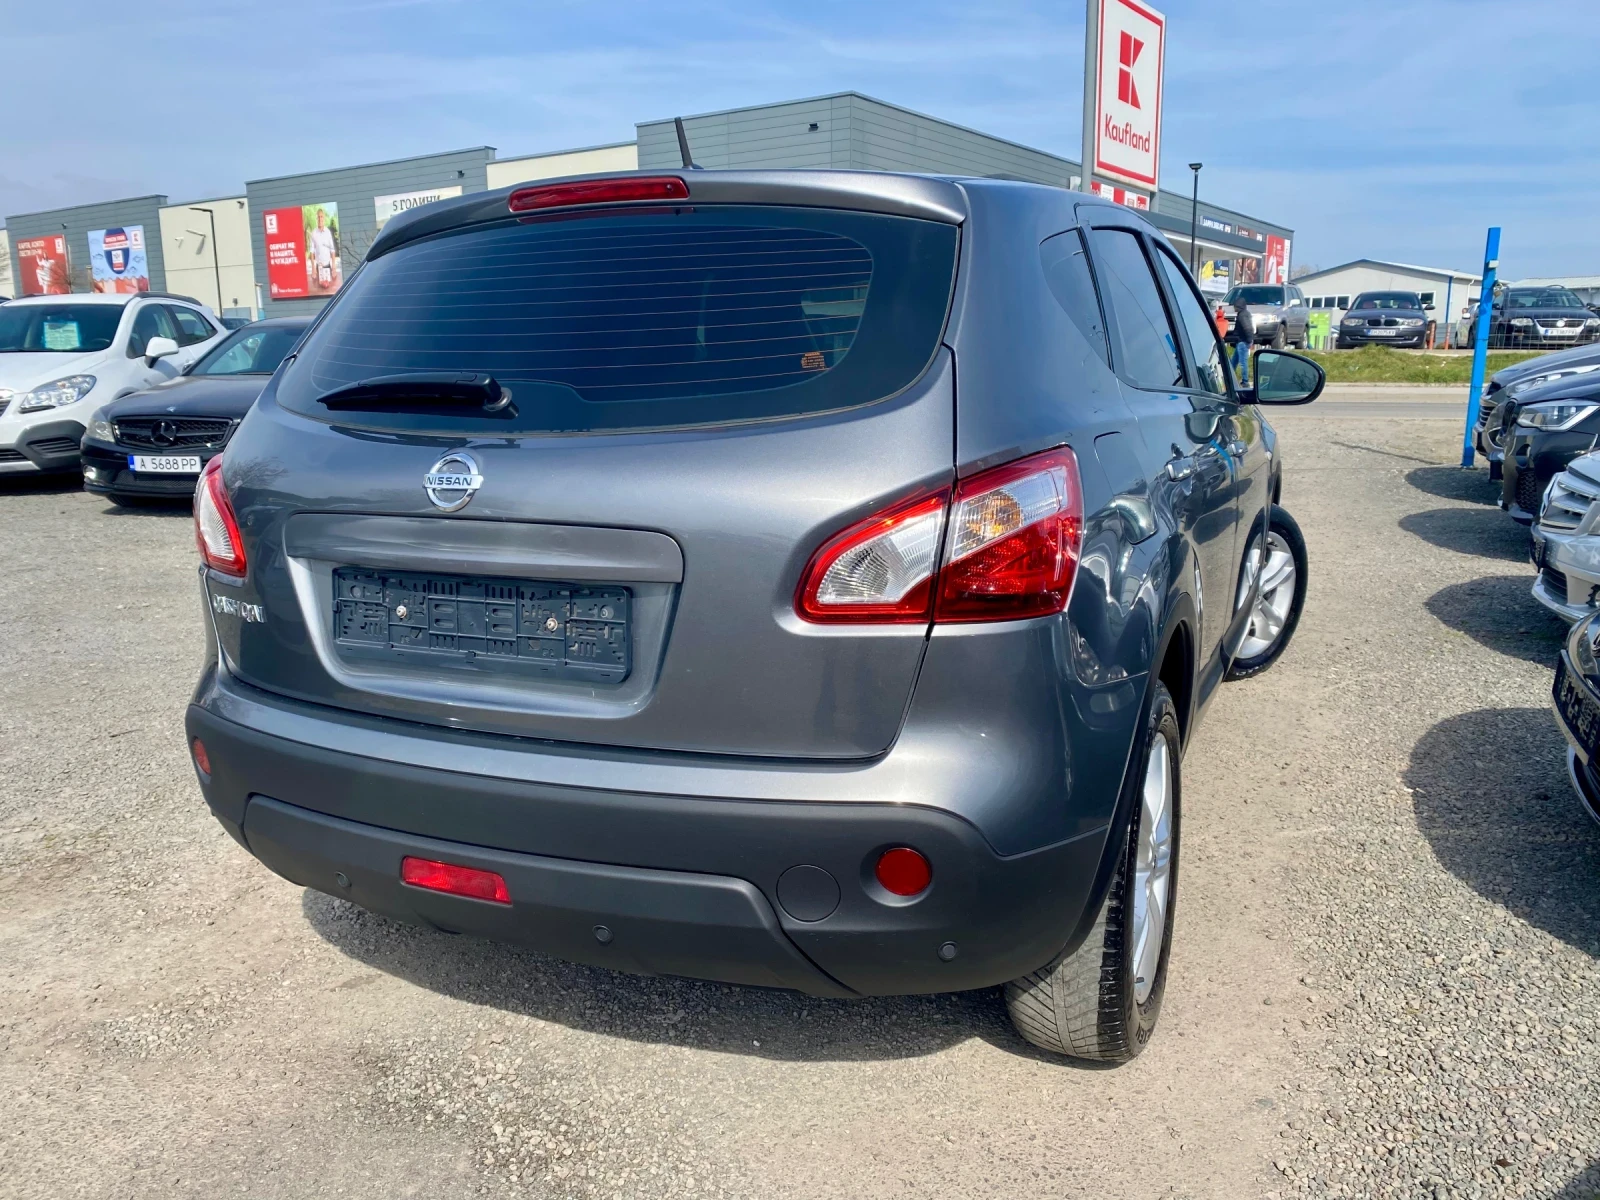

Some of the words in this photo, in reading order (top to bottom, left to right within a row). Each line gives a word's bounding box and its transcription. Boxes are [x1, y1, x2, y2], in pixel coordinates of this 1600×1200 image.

[1104, 113, 1151, 153] Kaufland
[392, 200, 398, 212] 5
[140, 458, 147, 469] A
[151, 458, 179, 470] 5688
[181, 458, 197, 470] PP
[425, 476, 473, 486] NISSAN
